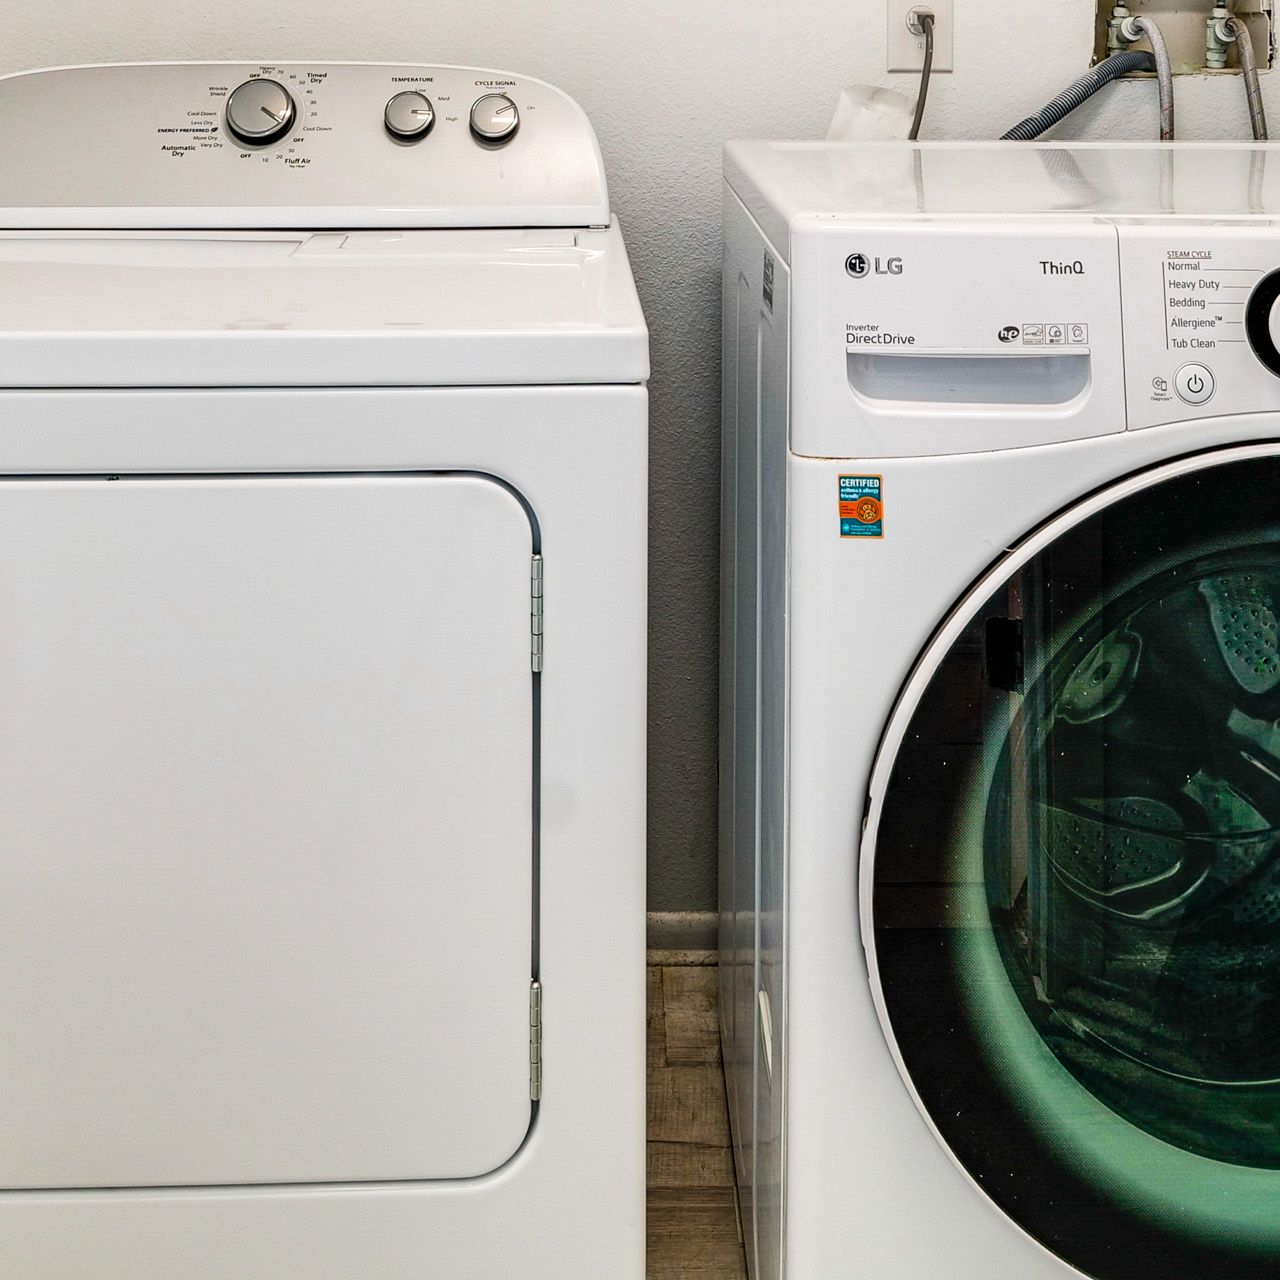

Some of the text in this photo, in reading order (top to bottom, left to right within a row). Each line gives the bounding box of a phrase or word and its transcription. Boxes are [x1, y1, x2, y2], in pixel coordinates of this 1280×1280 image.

[875, 257, 903, 275] LG
[1039, 260, 1085, 275] ThinQ
[1168, 261, 1200, 271] Normal
[1168, 280, 1220, 291] Heavy Duty
[1169, 298, 1206, 309] Bedding
[846, 323, 879, 331] Inverter
[1172, 339, 1216, 348] Tub Clean
[840, 478, 880, 488] CERTIFIED
